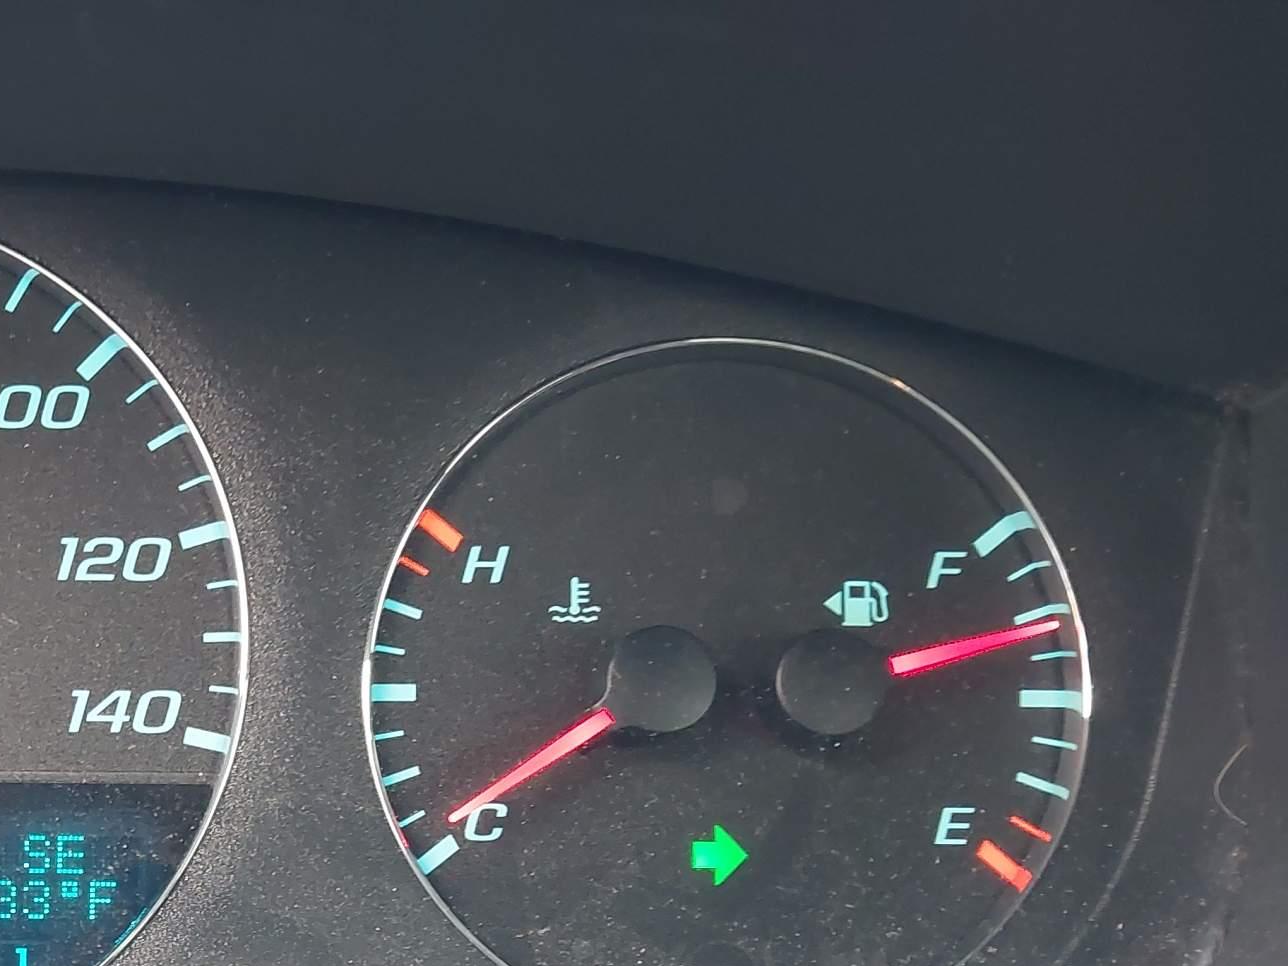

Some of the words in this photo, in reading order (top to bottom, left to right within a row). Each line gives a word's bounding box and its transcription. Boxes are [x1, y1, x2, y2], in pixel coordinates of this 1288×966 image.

[56, 535, 172, 583] 120
[461, 546, 511, 583] H
[925, 551, 968, 588] F
[67, 688, 182, 734] 140
[464, 802, 508, 842] C
[933, 807, 975, 844] E
[23, 833, 85, 875] SE
